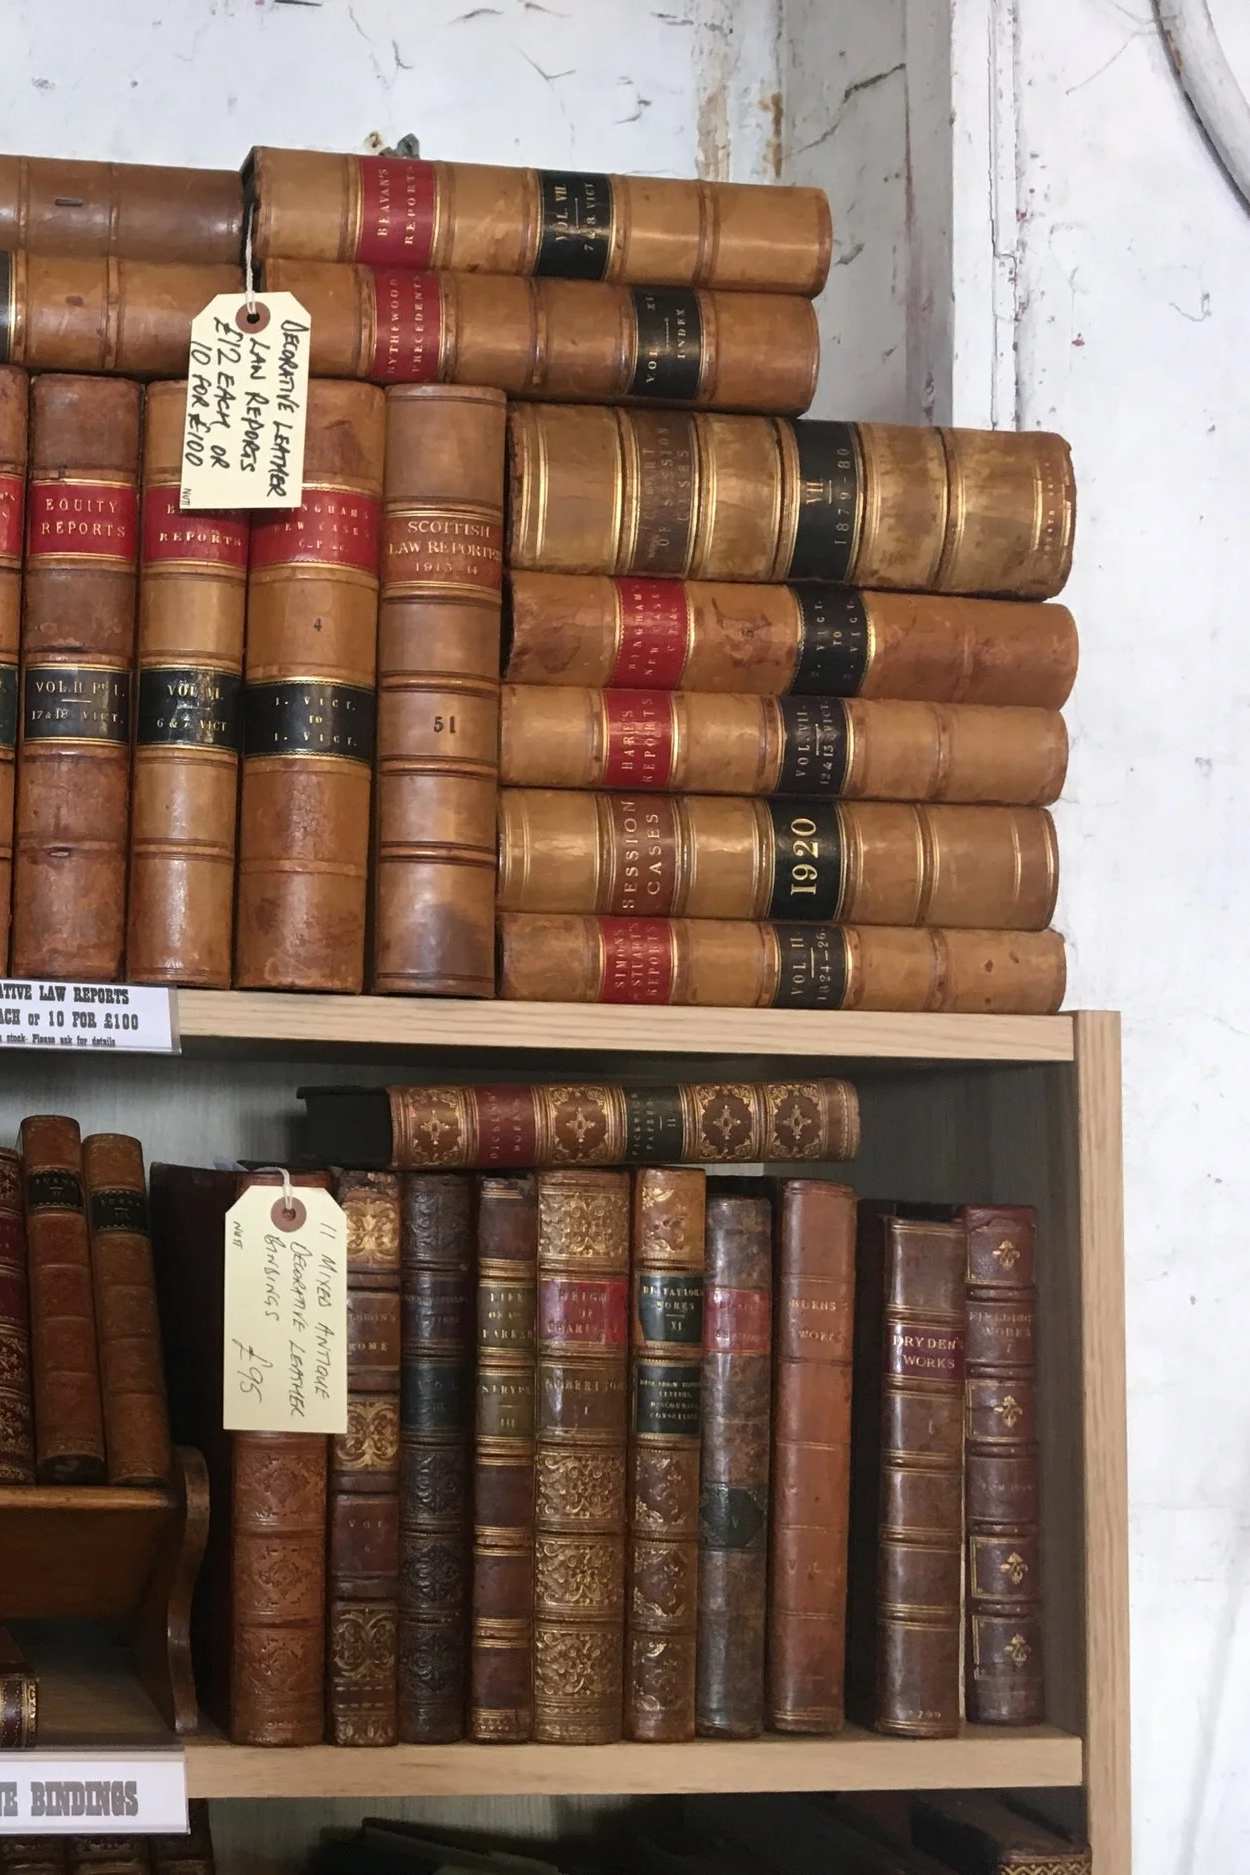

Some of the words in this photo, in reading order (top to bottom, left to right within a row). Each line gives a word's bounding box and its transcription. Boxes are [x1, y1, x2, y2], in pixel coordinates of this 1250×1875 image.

[405, 164, 417, 246] REPORTS
[214, 316, 244, 366] £12
[412, 273, 424, 374] PRECEDENTS
[676, 308, 686, 359] INDEX
[191, 340, 212, 366] 10
[249, 337, 271, 380] LAW
[280, 319, 310, 414] DECORATIVE
[192, 373, 212, 408] FOR
[210, 371, 237, 429] EACH
[184, 412, 211, 467] £100
[210, 444, 230, 469] OR
[239, 391, 270, 472] REPORTS
[266, 420, 293, 498] LEATHER
[45, 498, 119, 513] EQUITY
[835, 447, 851, 546] 1879-80
[41, 521, 126, 539] REPORTS
[389, 541, 422, 555] LAW
[407, 520, 491, 538] SCOTTISH
[313, 617, 323, 632] 4
[834, 631, 842, 646] TO
[156, 719, 165, 729] 6
[434, 716, 457, 735] 51
[642, 697, 655, 783] REPORTS
[622, 800, 639, 910] SESSION
[646, 813, 662, 895] CASES
[791, 817, 819, 896] 1920
[647, 926, 658, 996] REPORTS
[39, 985, 67, 1001] LAW
[73, 987, 130, 1005] REPORTS
[48, 1010, 65, 1028] 10
[72, 1011, 97, 1028] FOR
[103, 1013, 139, 1030] £100
[32, 1034, 56, 1045] Please
[59, 1035, 73, 1046] ask
[76, 1035, 88, 1047] for
[320, 1222, 338, 1240] 11
[289, 1240, 314, 1331] DECORATIVE
[316, 1253, 338, 1308] MIXED
[288, 1339, 308, 1419] LEATHER
[314, 1321, 336, 1401] ANTIQUE
[902, 1353, 956, 1370] WORKS
[30, 1780, 138, 1817] BINDINGS
